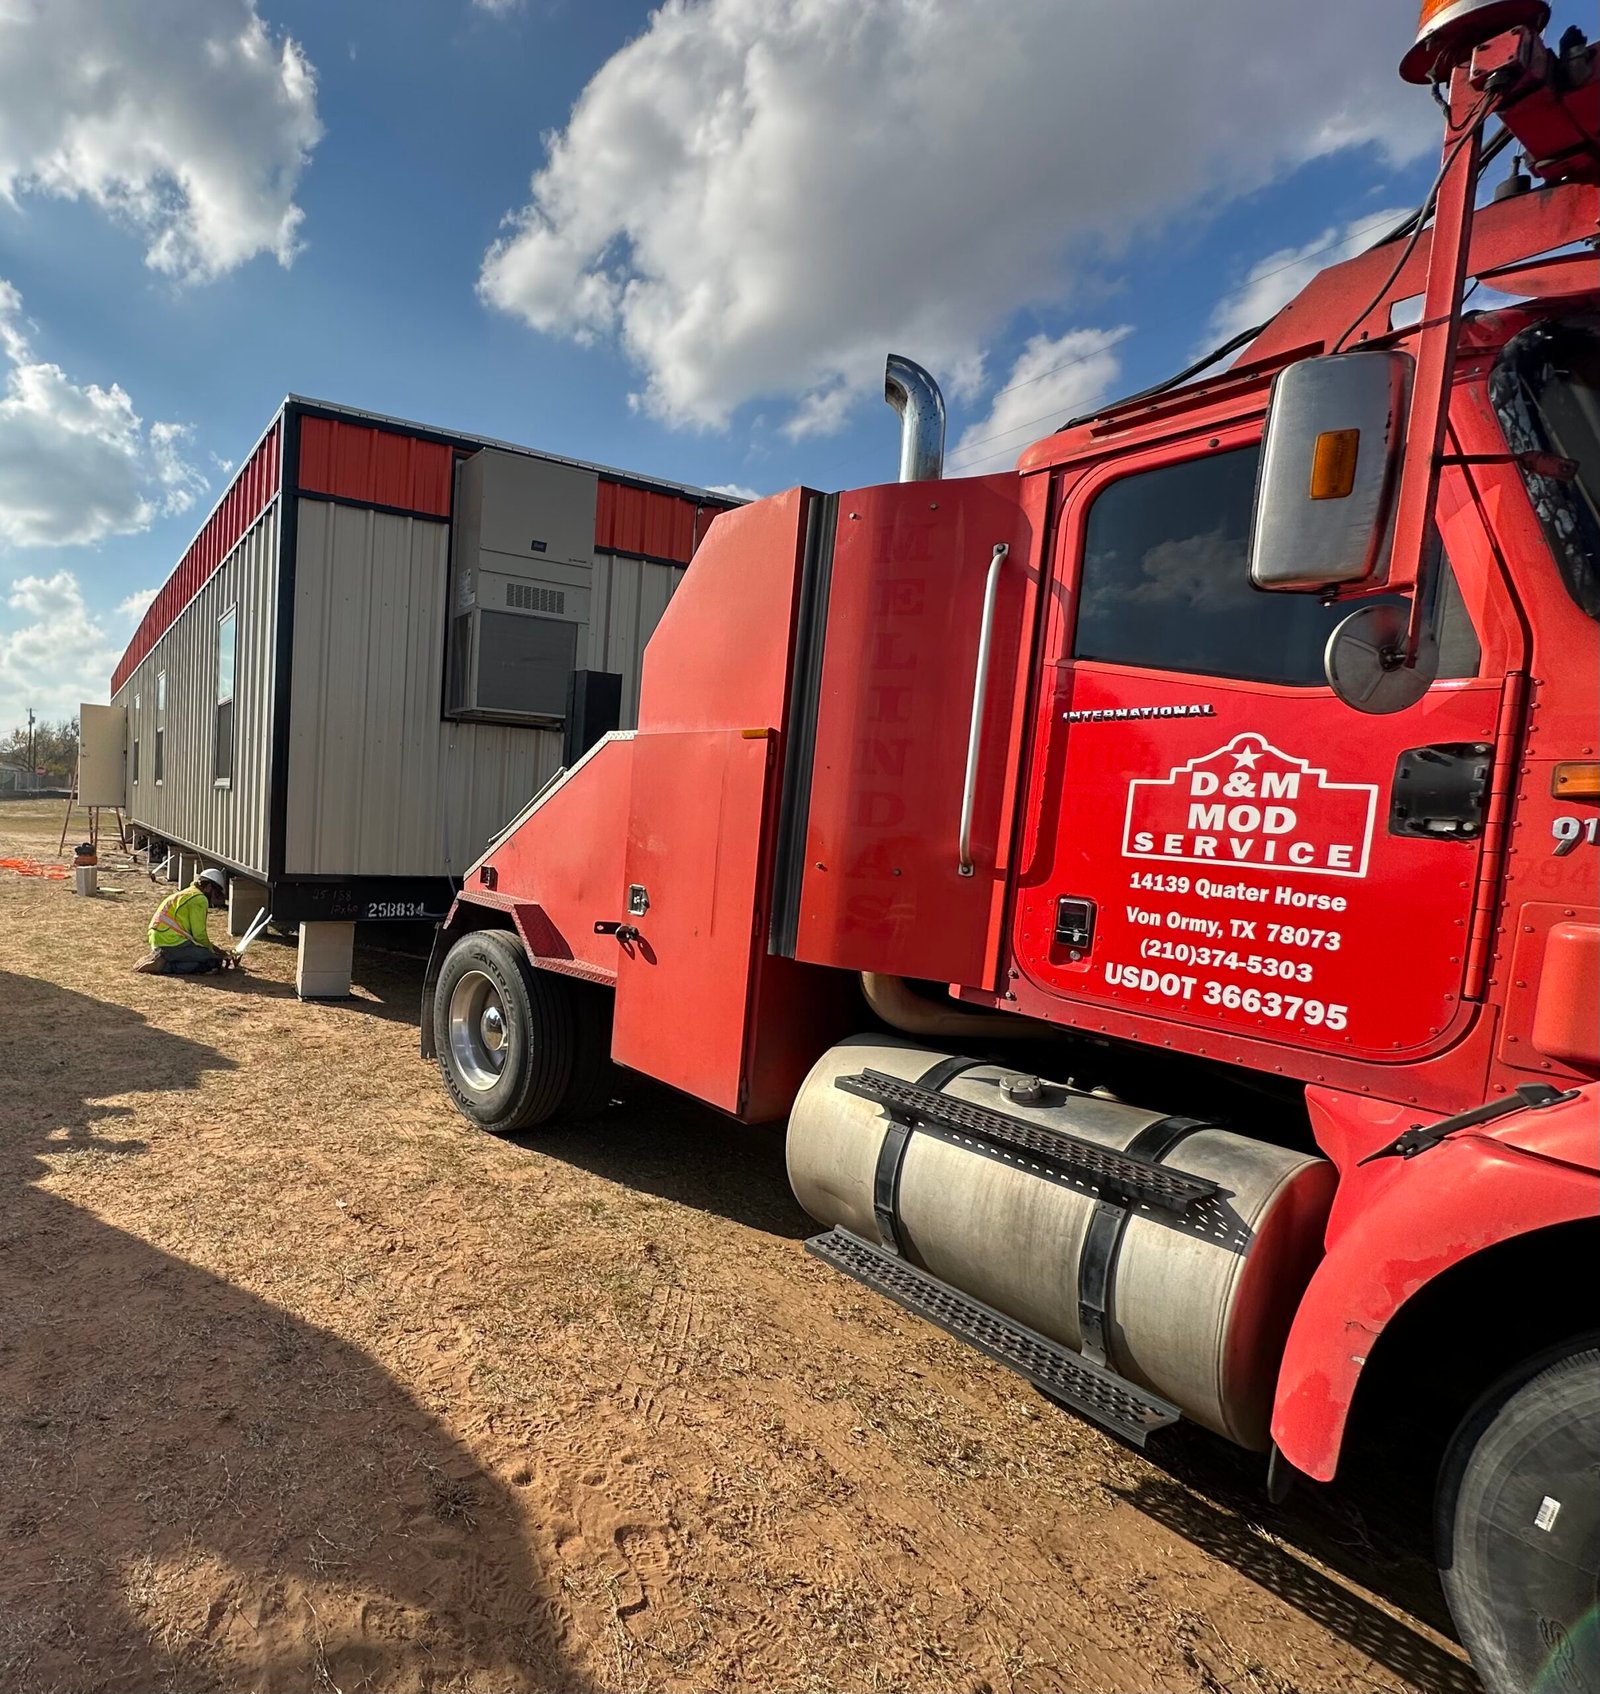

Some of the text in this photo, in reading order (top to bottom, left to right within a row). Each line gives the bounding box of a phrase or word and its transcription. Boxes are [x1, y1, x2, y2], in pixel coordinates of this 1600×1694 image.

[1062, 703, 1216, 722] INTERNATIONAL
[1190, 771, 1301, 799] D&M
[1187, 803, 1297, 835] MOD
[1133, 831, 1354, 868] SERVICE
[1129, 872, 1347, 912] 14139 Quater Horse
[1126, 905, 1341, 951] Von Ormy, TX 78073
[1140, 938, 1313, 983] (210)374-5303
[1104, 962, 1348, 1031] USDOT 3663795
